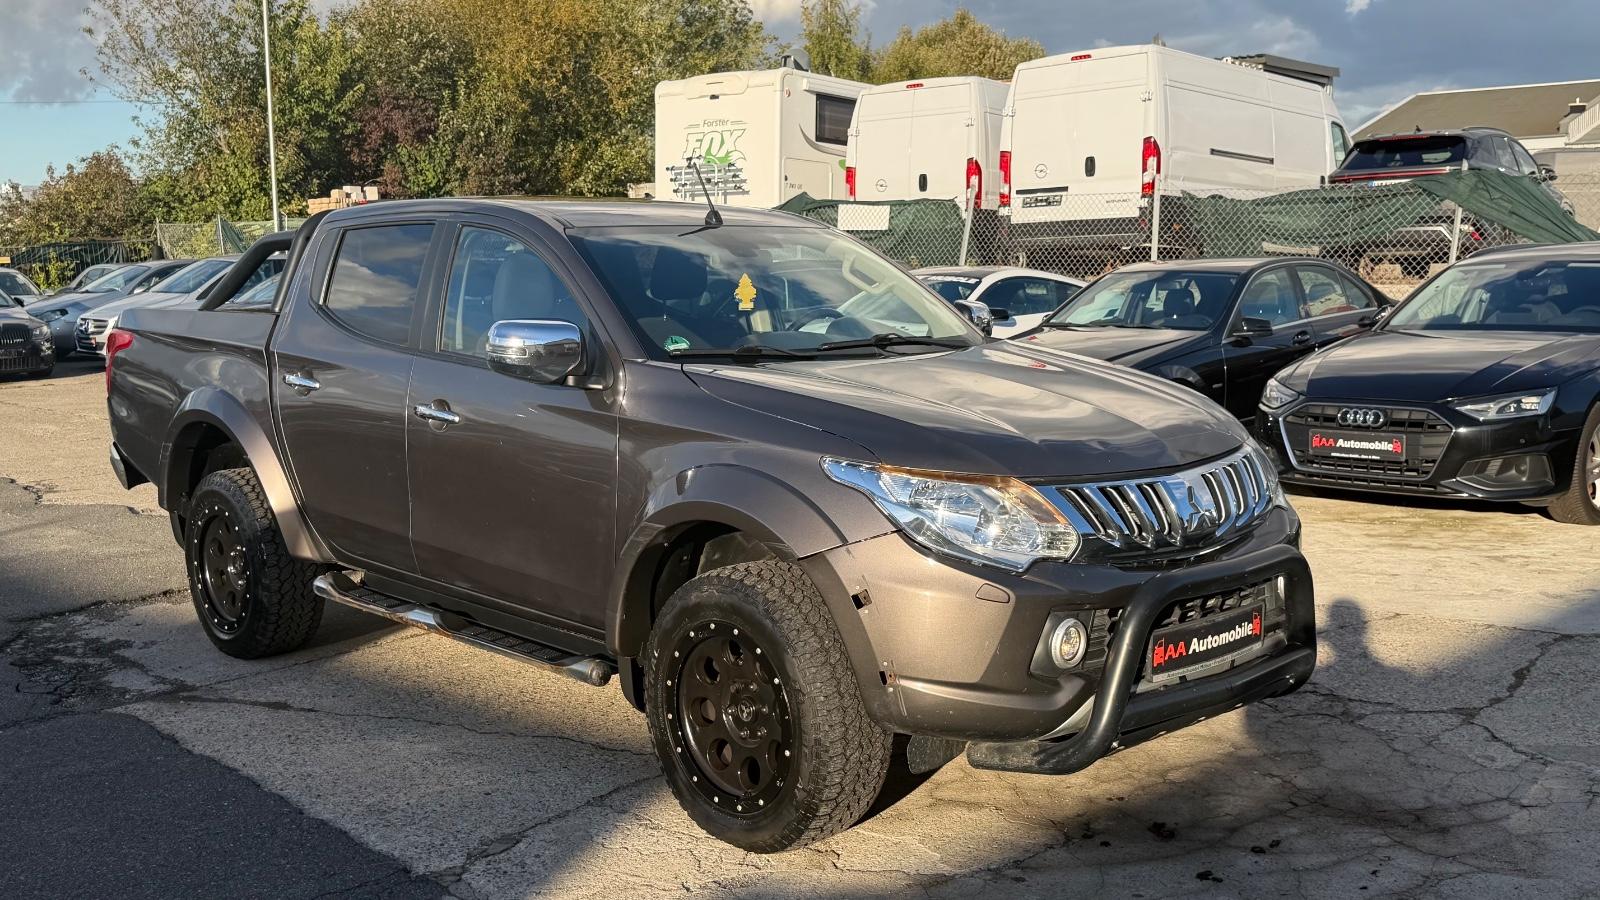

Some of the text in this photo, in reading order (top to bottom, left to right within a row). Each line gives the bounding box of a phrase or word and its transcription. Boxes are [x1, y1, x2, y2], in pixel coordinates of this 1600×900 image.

[703, 119, 729, 127] Forster
[682, 129, 746, 160] FOX
[1320, 438, 1393, 451] AA Automobile
[1165, 622, 1253, 660] AA Automobile
